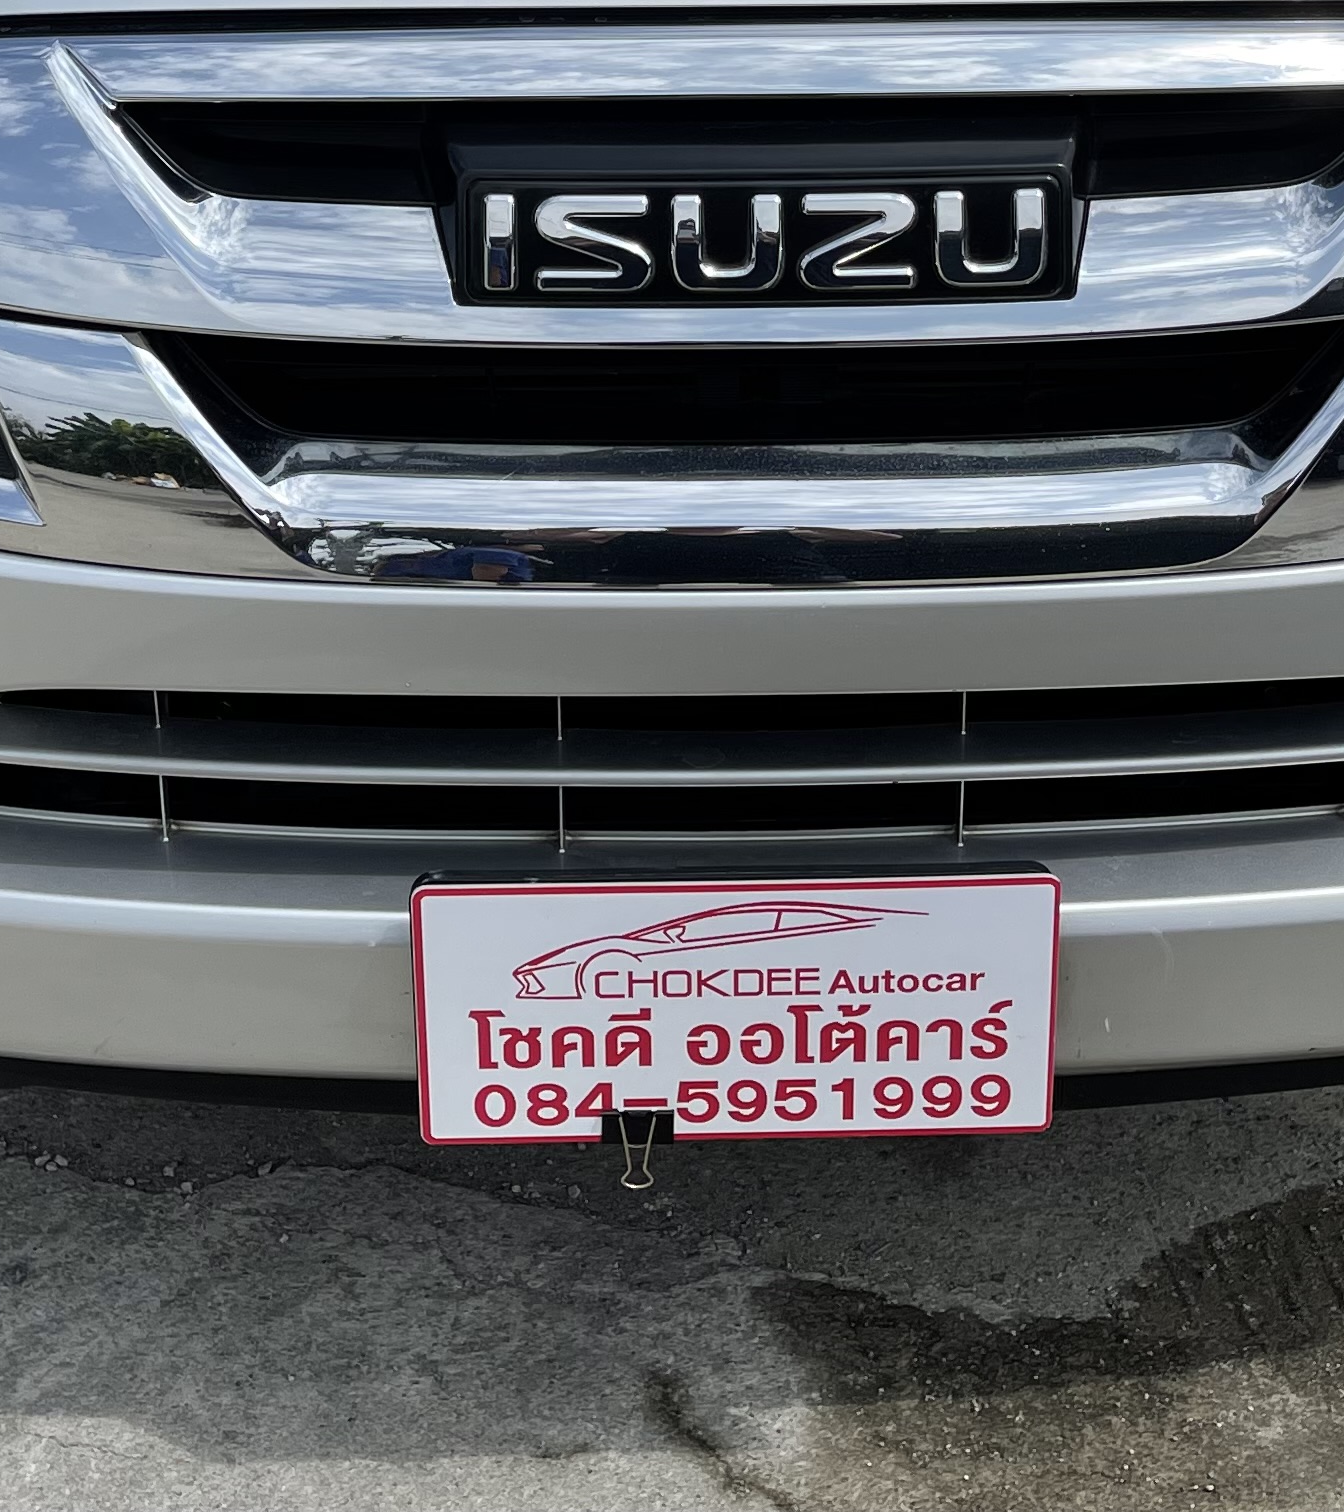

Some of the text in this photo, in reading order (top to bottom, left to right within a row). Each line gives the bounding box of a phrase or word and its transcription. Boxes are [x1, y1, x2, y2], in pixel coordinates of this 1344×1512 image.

[482, 188, 1045, 292] ISUZU
[594, 968, 986, 999] CHOKDEE Autocar
[468, 999, 1013, 1070] โชคดี ออโต้คาร์
[473, 1074, 1012, 1127] 084-5951999
